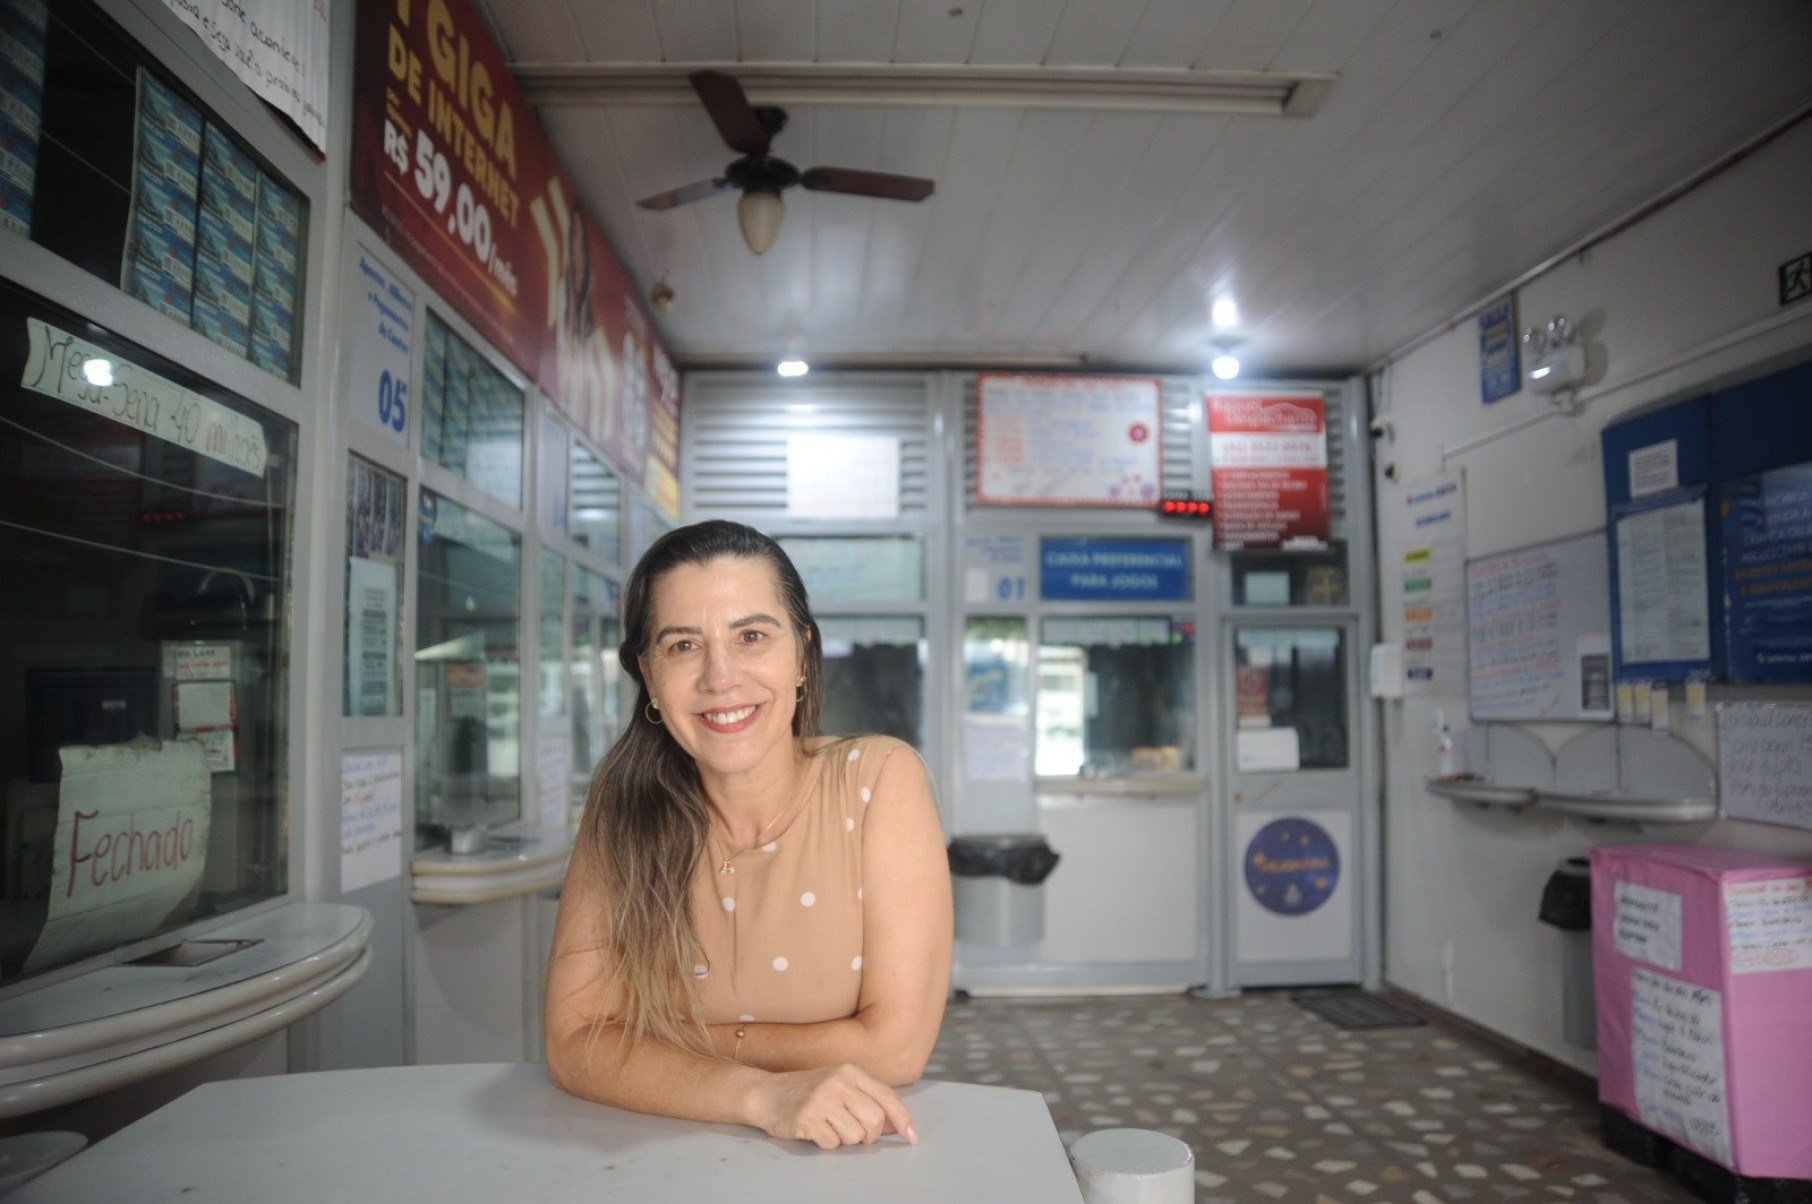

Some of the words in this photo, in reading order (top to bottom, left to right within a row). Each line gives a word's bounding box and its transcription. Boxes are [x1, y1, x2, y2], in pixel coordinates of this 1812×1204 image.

[384, 118, 409, 175] R$
[388, 23, 423, 107] DE
[428, 78, 519, 230] INTERNET
[170, 388, 200, 444] 40
[378, 368, 407, 432] 05
[997, 577, 1025, 600] 01
[67, 809, 195, 899] Fechado
